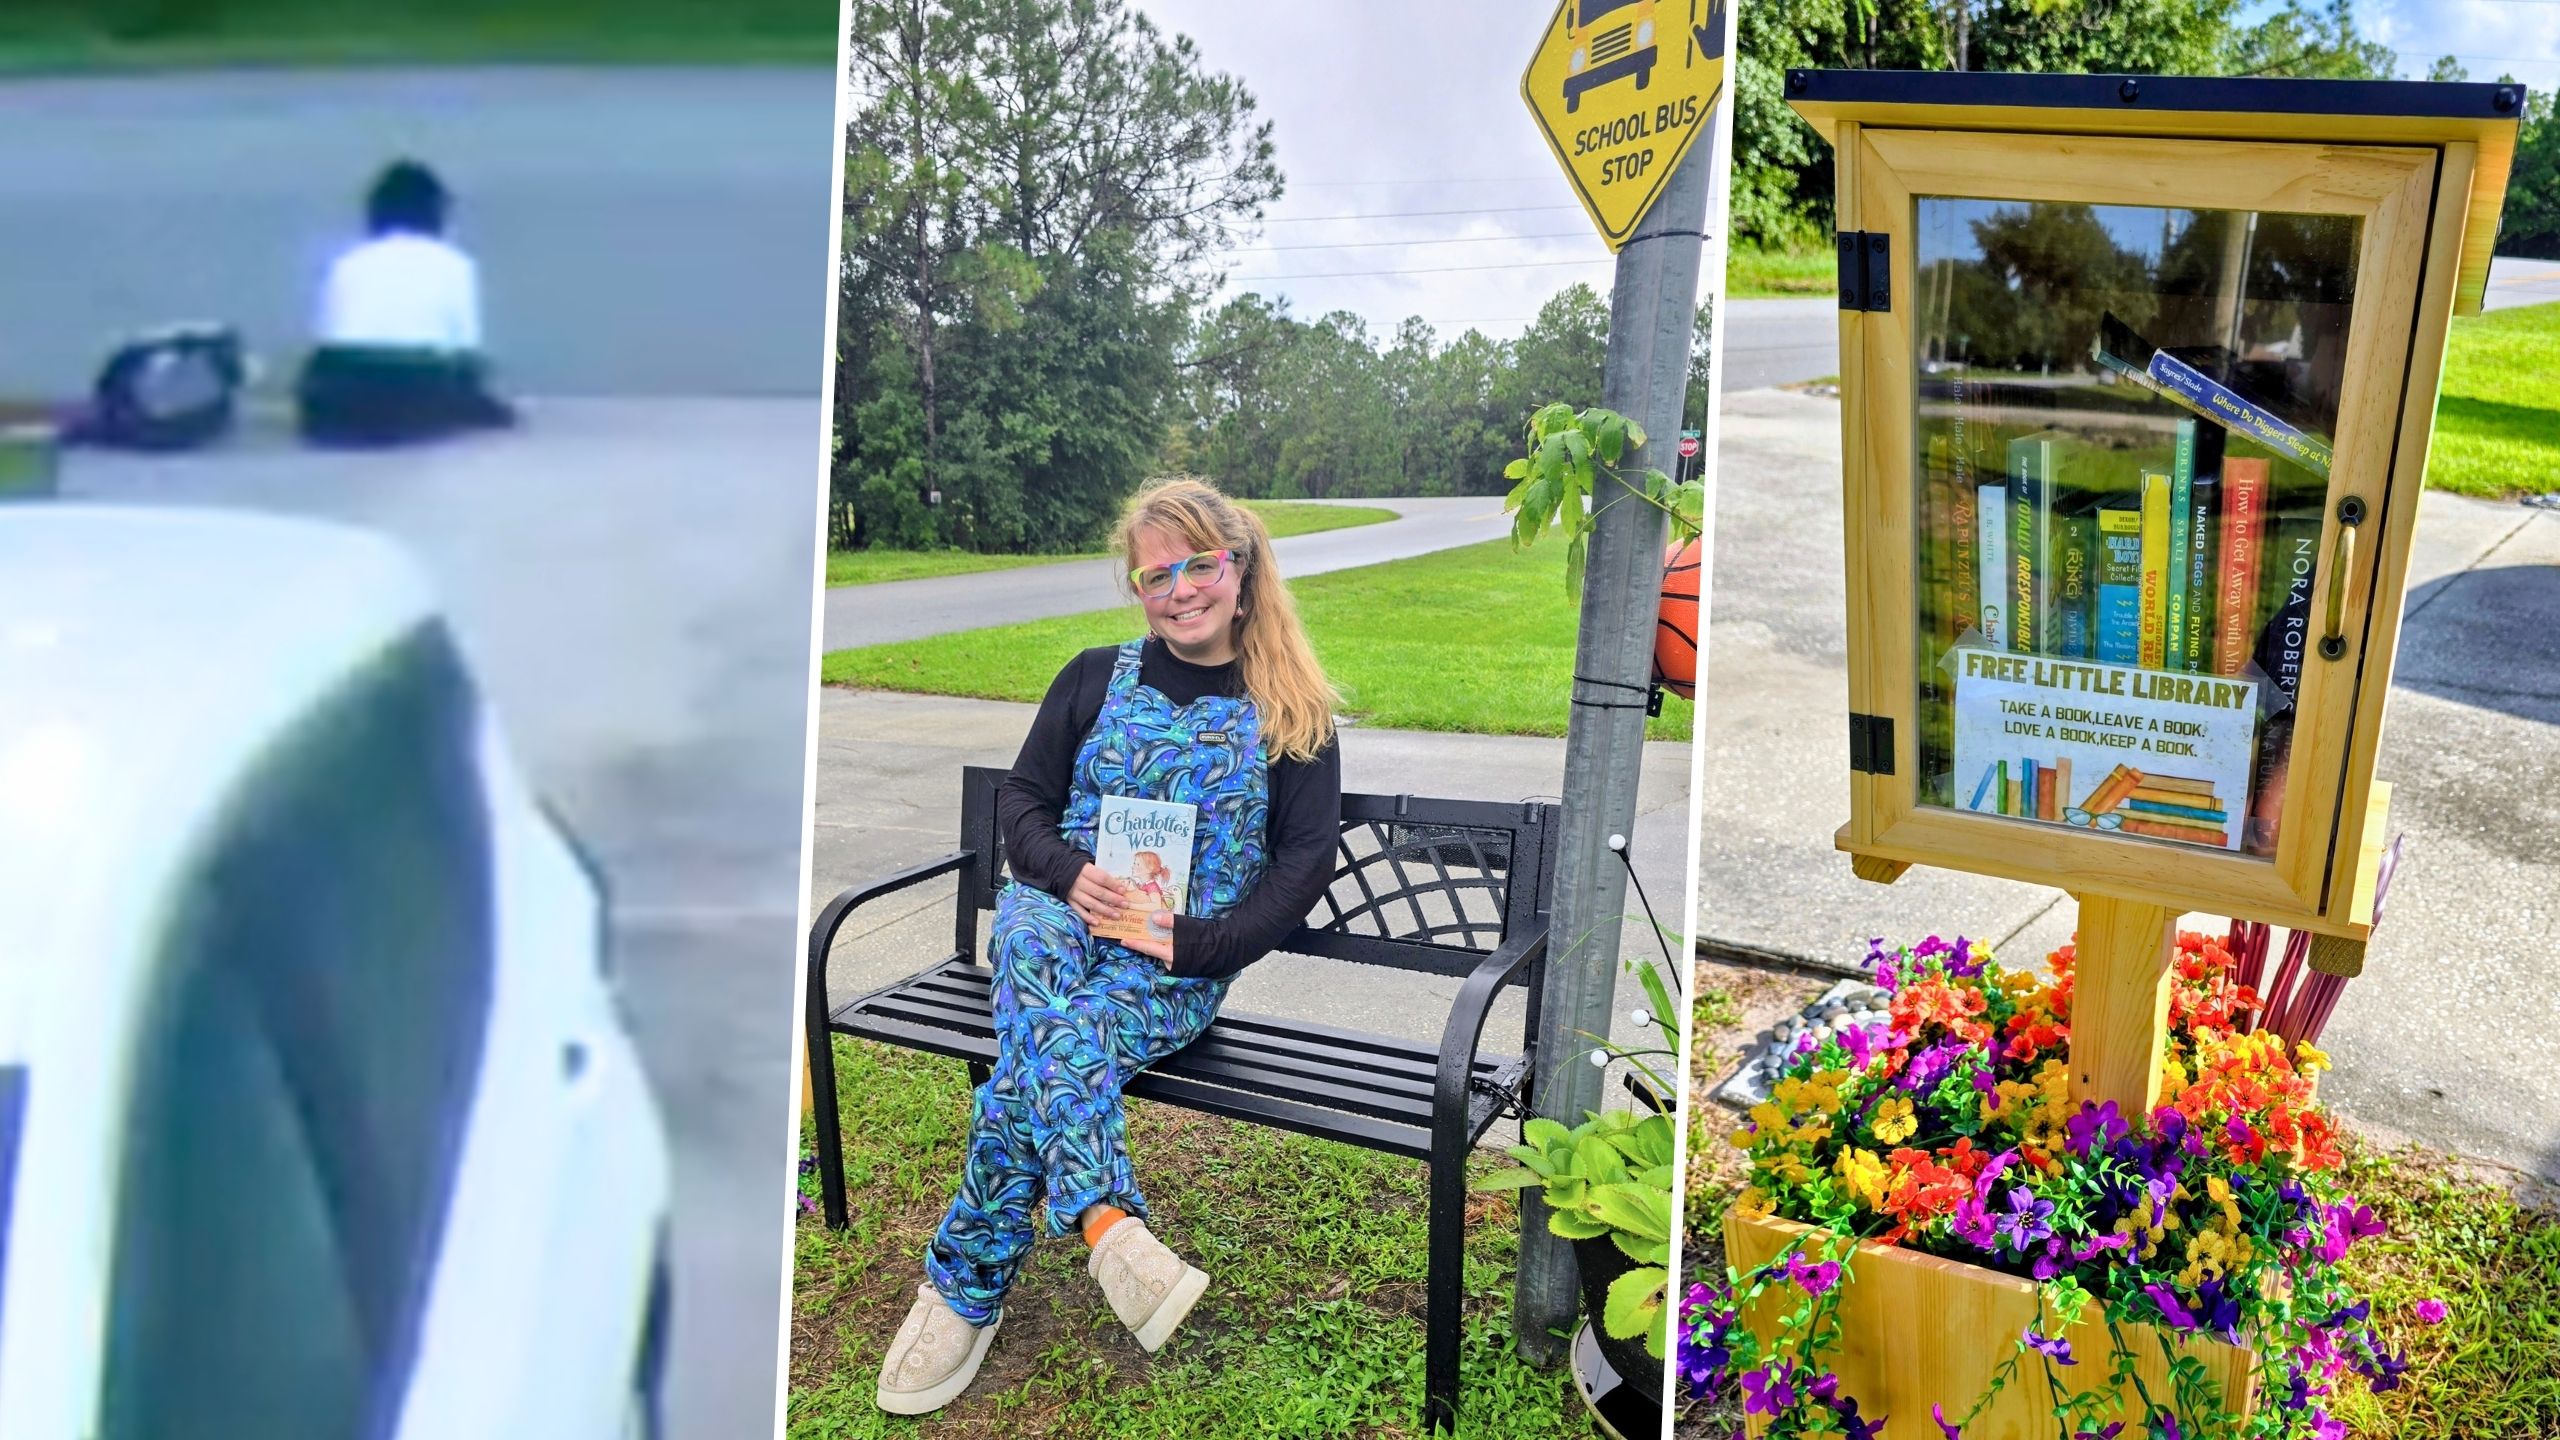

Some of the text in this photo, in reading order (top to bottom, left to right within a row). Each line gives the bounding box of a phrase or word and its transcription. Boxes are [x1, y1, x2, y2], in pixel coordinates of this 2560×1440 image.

[1574, 95, 1698, 156] SCHOOL BUS
[1601, 149, 1654, 186] STOP
[1953, 376, 1965, 484] Hale Hale Hale
[2212, 393, 2240, 415] Where
[2241, 408, 2254, 423] Do
[2254, 416, 2286, 442] Diggers
[2287, 436, 2310, 458] Sleep
[2310, 452, 2321, 462] at
[1680, 442, 1698, 452] STOP
[2174, 439, 2189, 564] YORINKS SMALL
[2236, 479, 2254, 514] How
[2070, 526, 2078, 537] 2
[2195, 505, 2206, 549] NAKED
[2235, 520, 2248, 534] to
[2106, 564, 2129, 572] Secret
[2233, 538, 2249, 562] Get
[2017, 496, 2032, 653] TOTALLY IRRESPONSIBLE
[2193, 553, 2204, 587] EGGS
[2226, 567, 2246, 609] Away
[2289, 538, 2313, 606] NORA
[2144, 571, 2157, 634] WORLD
[2191, 590, 2201, 613] AND
[2190, 616, 2200, 657] FLYING
[2226, 613, 2242, 645] with
[1966, 653, 2250, 710] FREE LITTLE LIBRARY
[2000, 699, 2037, 717] TAKE
[2041, 705, 2051, 718] A
[2148, 718, 2159, 732] A
[2163, 720, 2206, 738] BOOK.
[2004, 720, 2041, 737] LOVE
[2045, 726, 2055, 739] A
[2141, 738, 2151, 751] A
[2156, 740, 2198, 758] BOOK.
[1104, 807, 1190, 838] Charlotte's
[1126, 830, 1166, 851] Web
